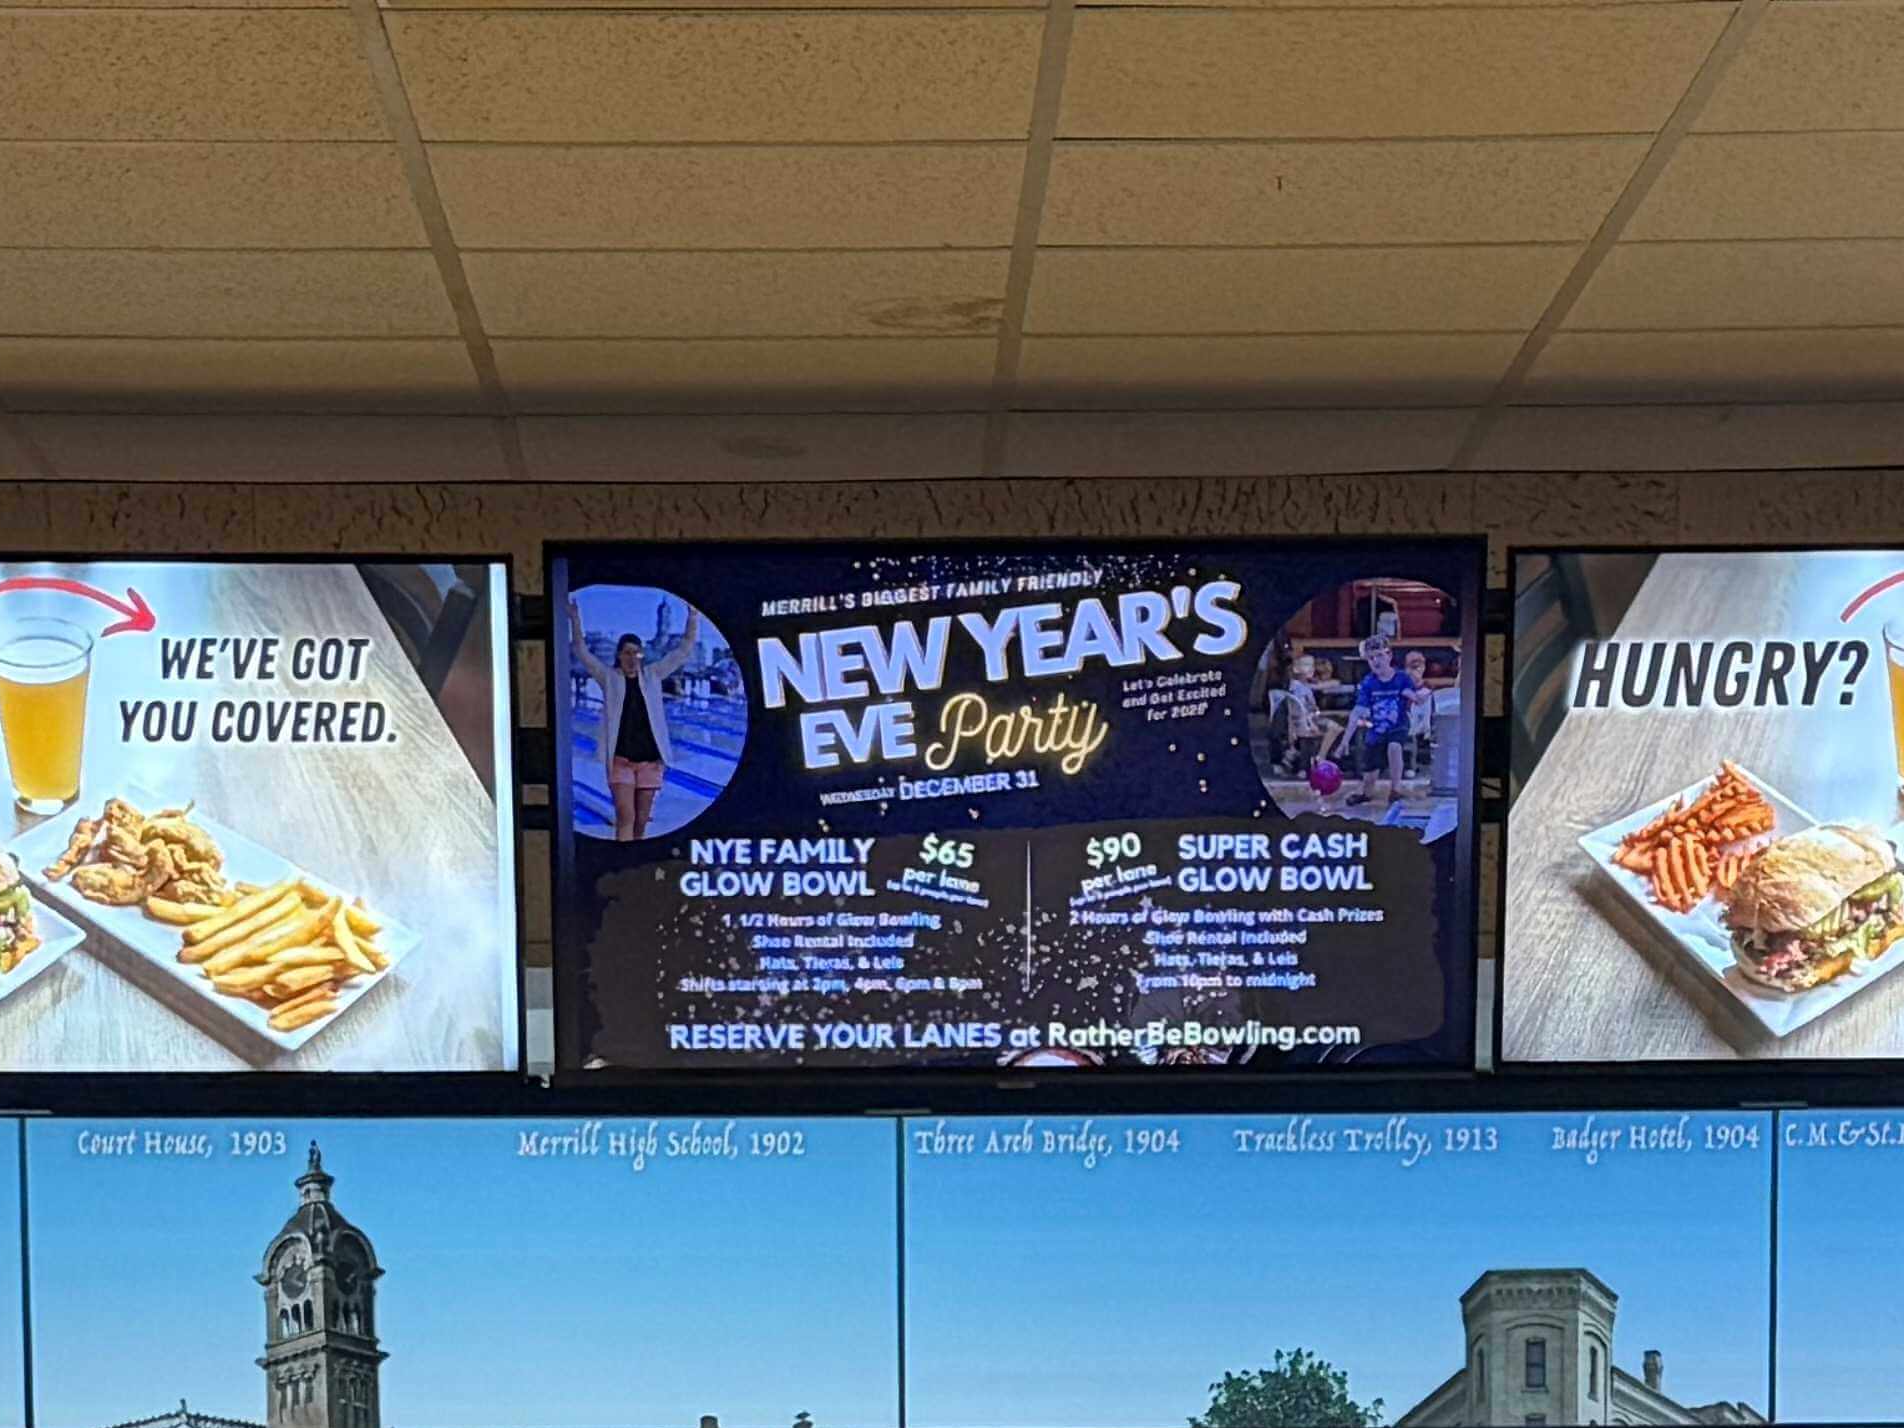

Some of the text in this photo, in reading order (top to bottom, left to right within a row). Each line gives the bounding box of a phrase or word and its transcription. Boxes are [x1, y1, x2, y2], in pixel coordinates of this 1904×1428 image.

[761, 568, 1103, 617] MERRILL'S BIGGEST FAMILY FRIENDLY
[159, 637, 371, 682] WE'VE GOT
[757, 580, 1249, 709] NEW YEAR'S
[1572, 638, 1871, 707] HUNGRY?
[118, 700, 399, 743] YOU COVERED.
[799, 701, 917, 768] EVE
[924, 692, 1109, 775] Party
[899, 770, 1040, 801] DECEMBER 31
[690, 837, 876, 865] NYE FAMILY
[919, 832, 976, 868] $65
[1086, 831, 1142, 870] $90
[1178, 832, 1369, 860] SUPER CASH
[679, 870, 774, 897] GLOW
[783, 870, 876, 897] BOWL
[1179, 865, 1274, 892] GLOW
[1280, 865, 1374, 892] BOWL
[1258, 908, 1294, 923] with
[1296, 908, 1335, 923] Cash
[1337, 907, 1385, 923] Prizes
[670, 1020, 1361, 1051] RESERVE YOUR LANES at RatherBeBowling.com
[78, 1130, 288, 1159] Court House, 1903
[517, 1121, 806, 1171] Merrill High School, 1902
[913, 1119, 1181, 1169] Three Arch Bridge, 1904
[1233, 1115, 1499, 1167] Trackless Trolley, 1913
[1551, 1114, 1761, 1165] Badger Hotel, 1904
